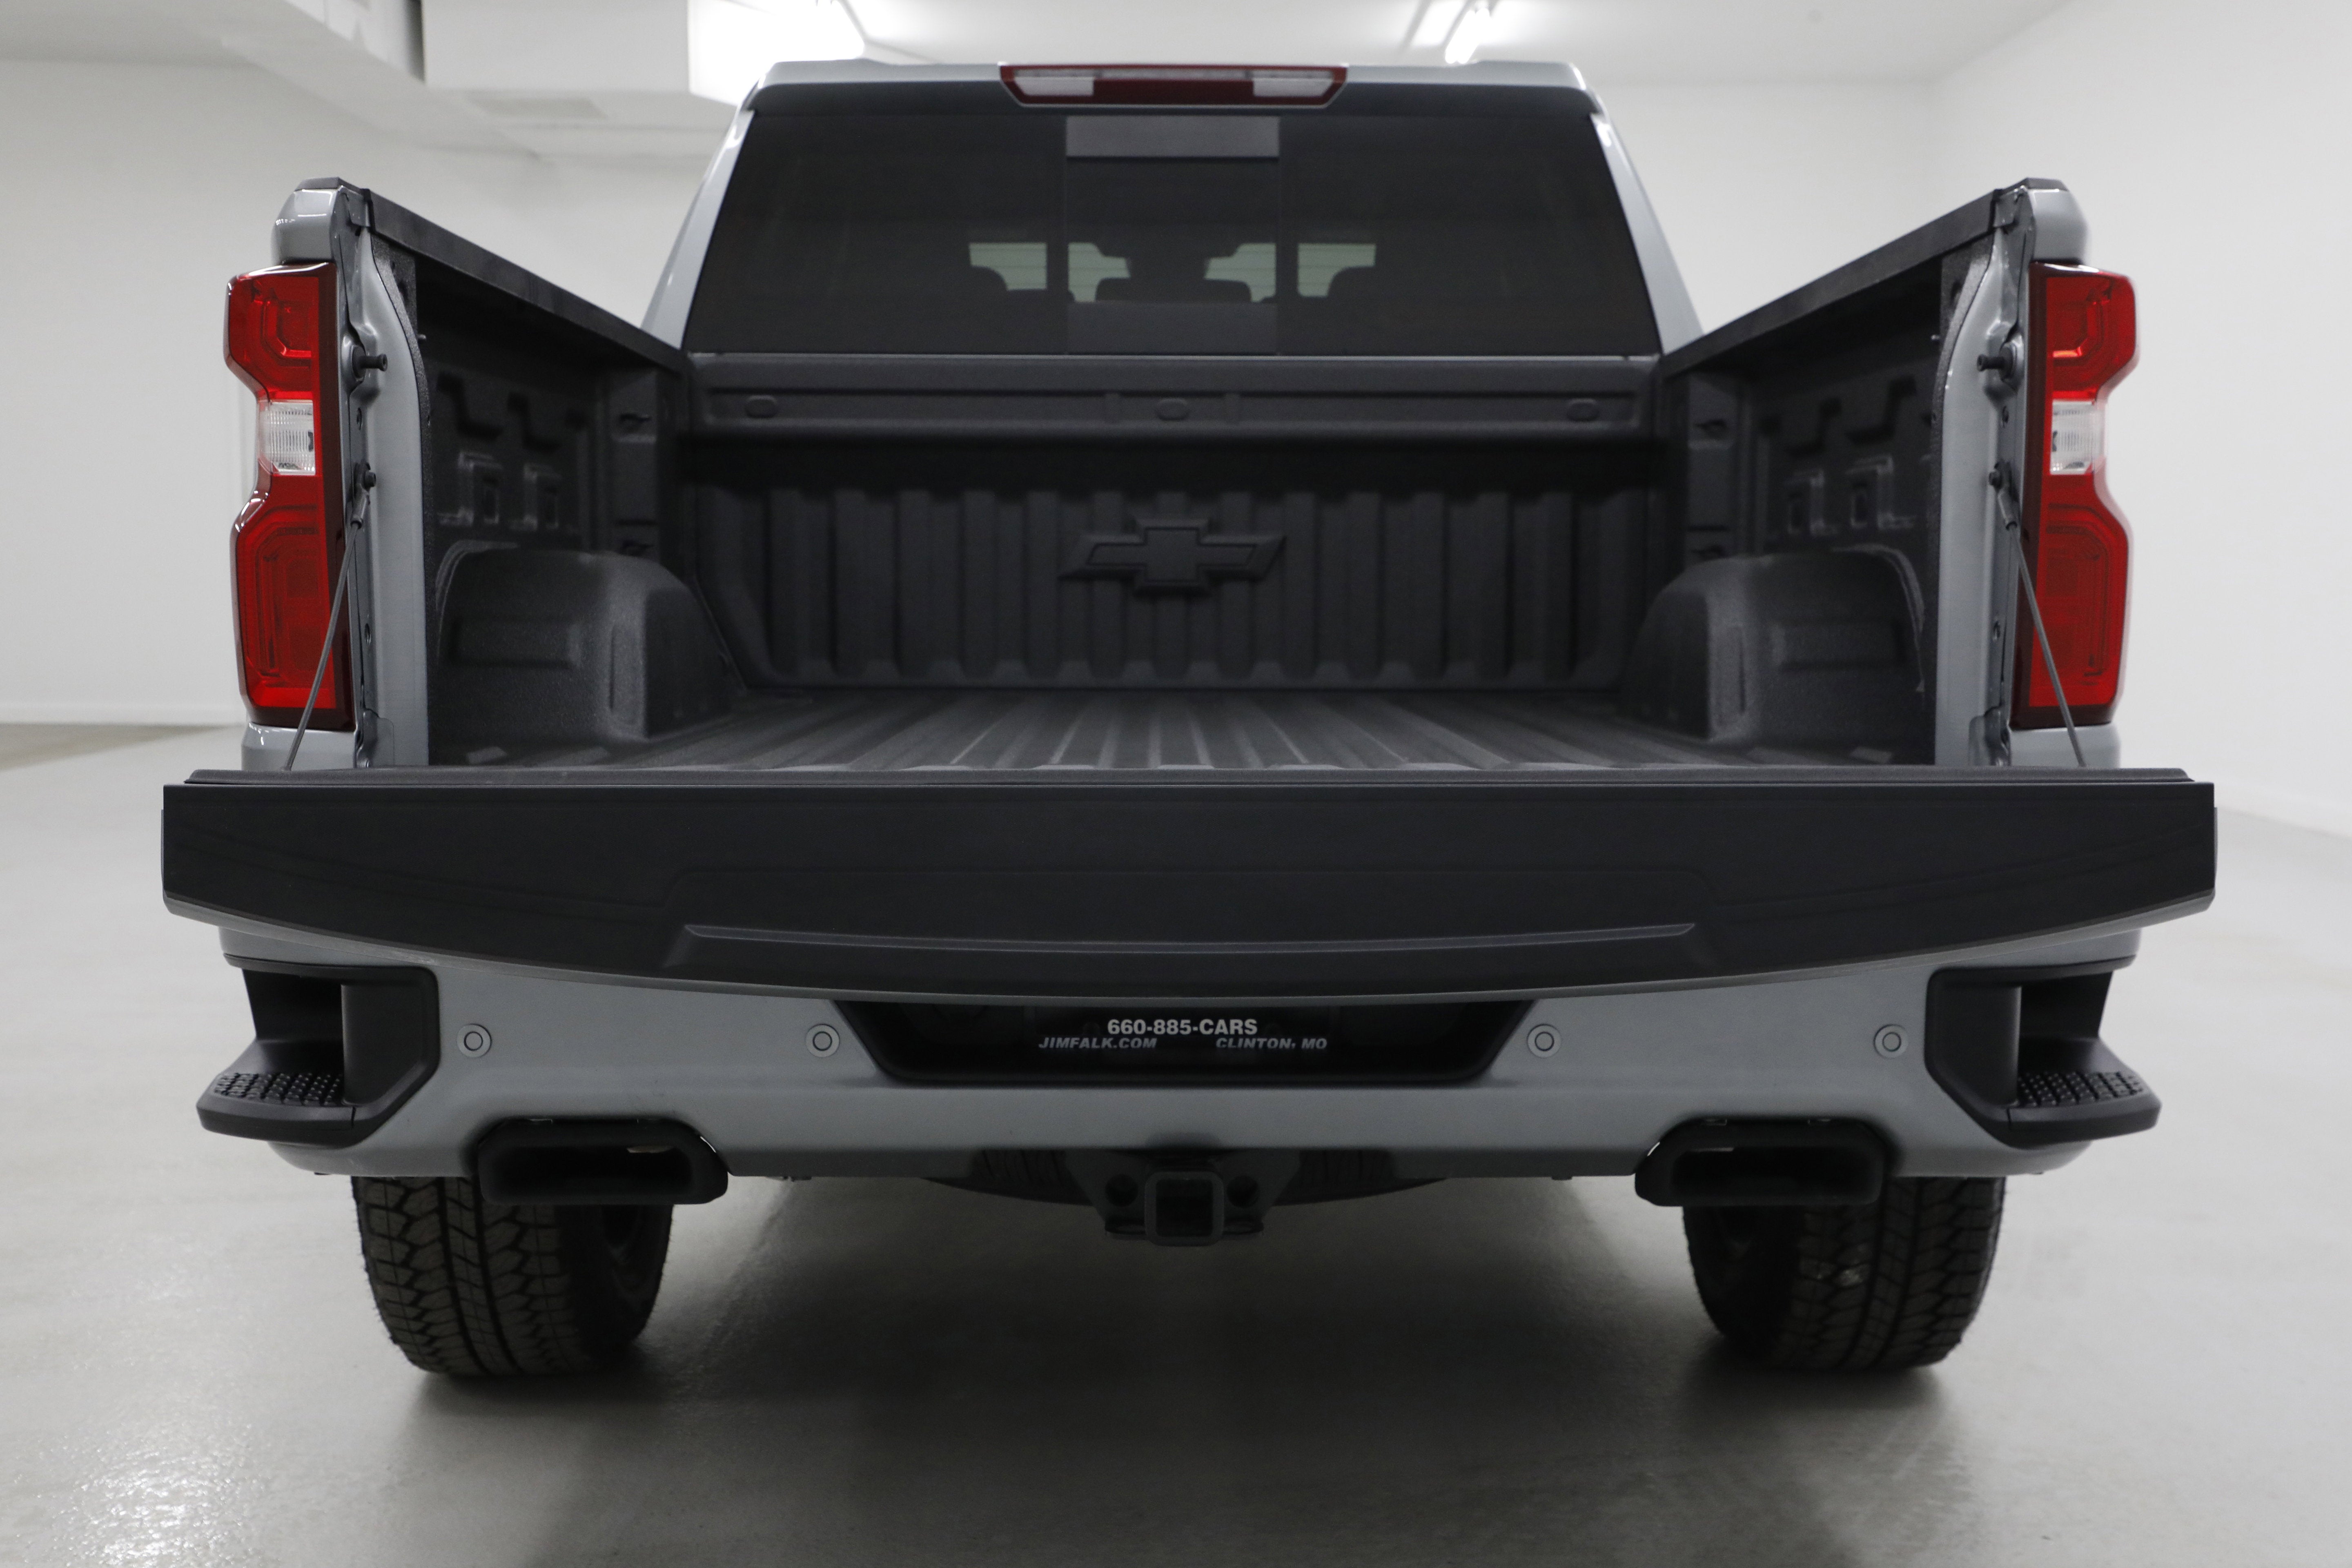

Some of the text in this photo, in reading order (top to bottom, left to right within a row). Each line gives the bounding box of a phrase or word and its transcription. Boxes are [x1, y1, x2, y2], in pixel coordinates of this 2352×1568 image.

[1107, 1019, 1257, 1035] 660-885-CARS
[1038, 1037, 1157, 1049] JIMFALK.COM
[1216, 1037, 1327, 1049] CLINTON, MO
